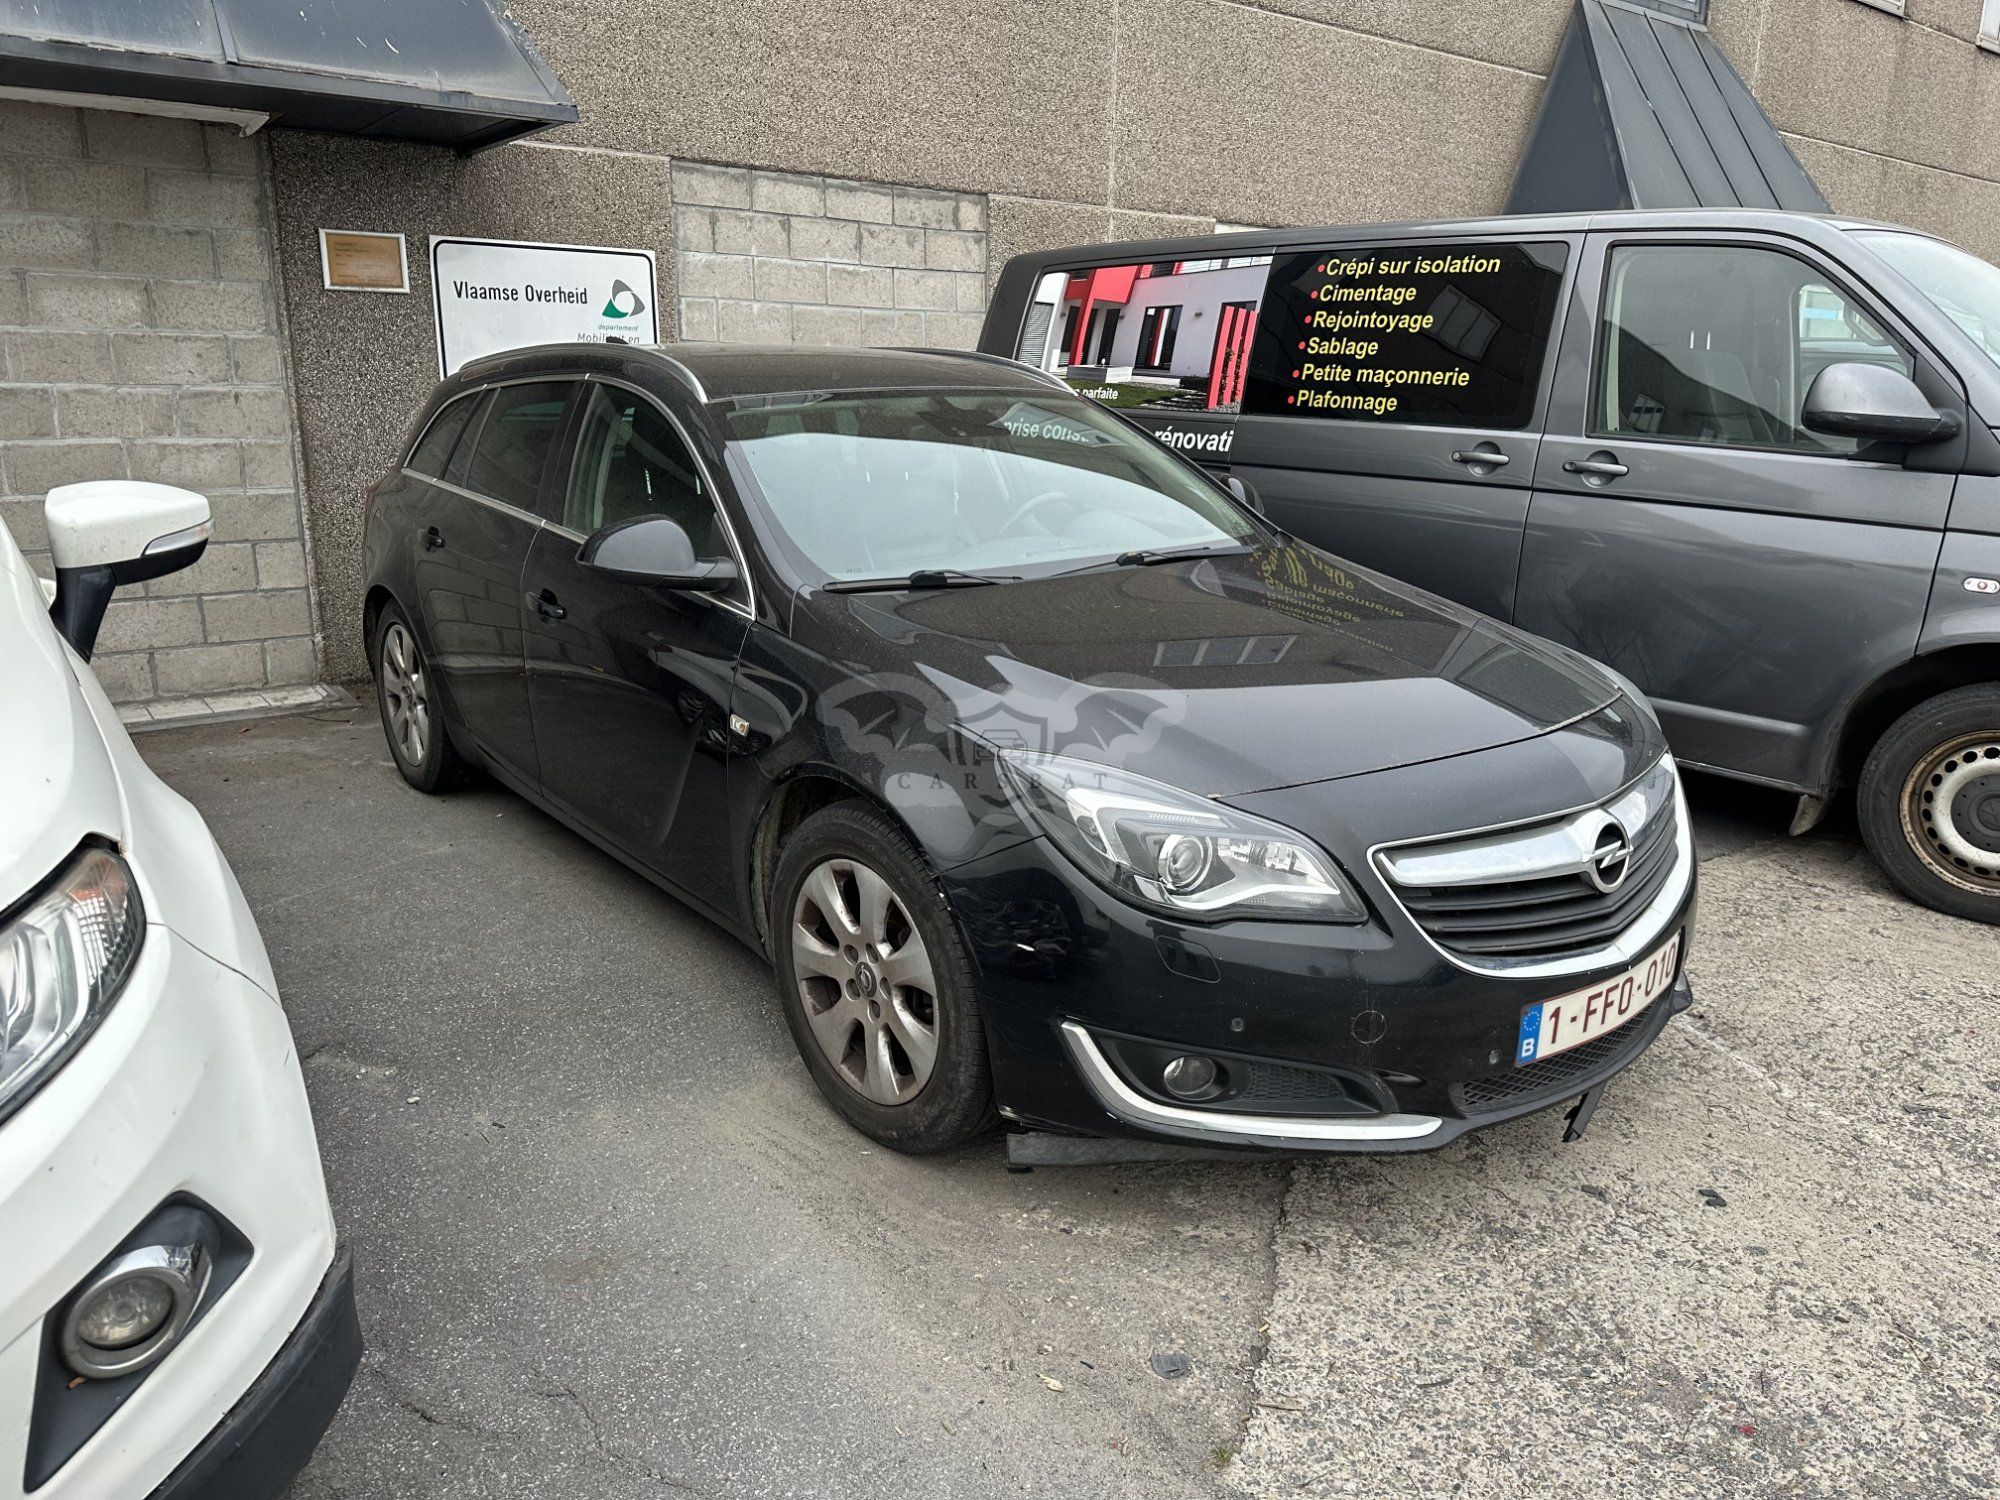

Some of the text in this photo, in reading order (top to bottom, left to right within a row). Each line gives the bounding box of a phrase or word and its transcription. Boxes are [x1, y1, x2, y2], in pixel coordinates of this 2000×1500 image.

[1326, 256, 1501, 279] Crépi sur isolation
[453, 280, 588, 304] Vlaamse Overheid
[1319, 284, 1417, 305] Cimentage
[598, 323, 639, 333] departement
[1313, 310, 1434, 333] Rejointoyage
[1306, 337, 1379, 359] Sablage
[1301, 363, 1470, 387] Petite maçonnerie
[1296, 389, 1398, 415] Plafonnage
[1549, 942, 1677, 1045] 1-FFO-010
[1521, 1038, 1535, 1058] B
